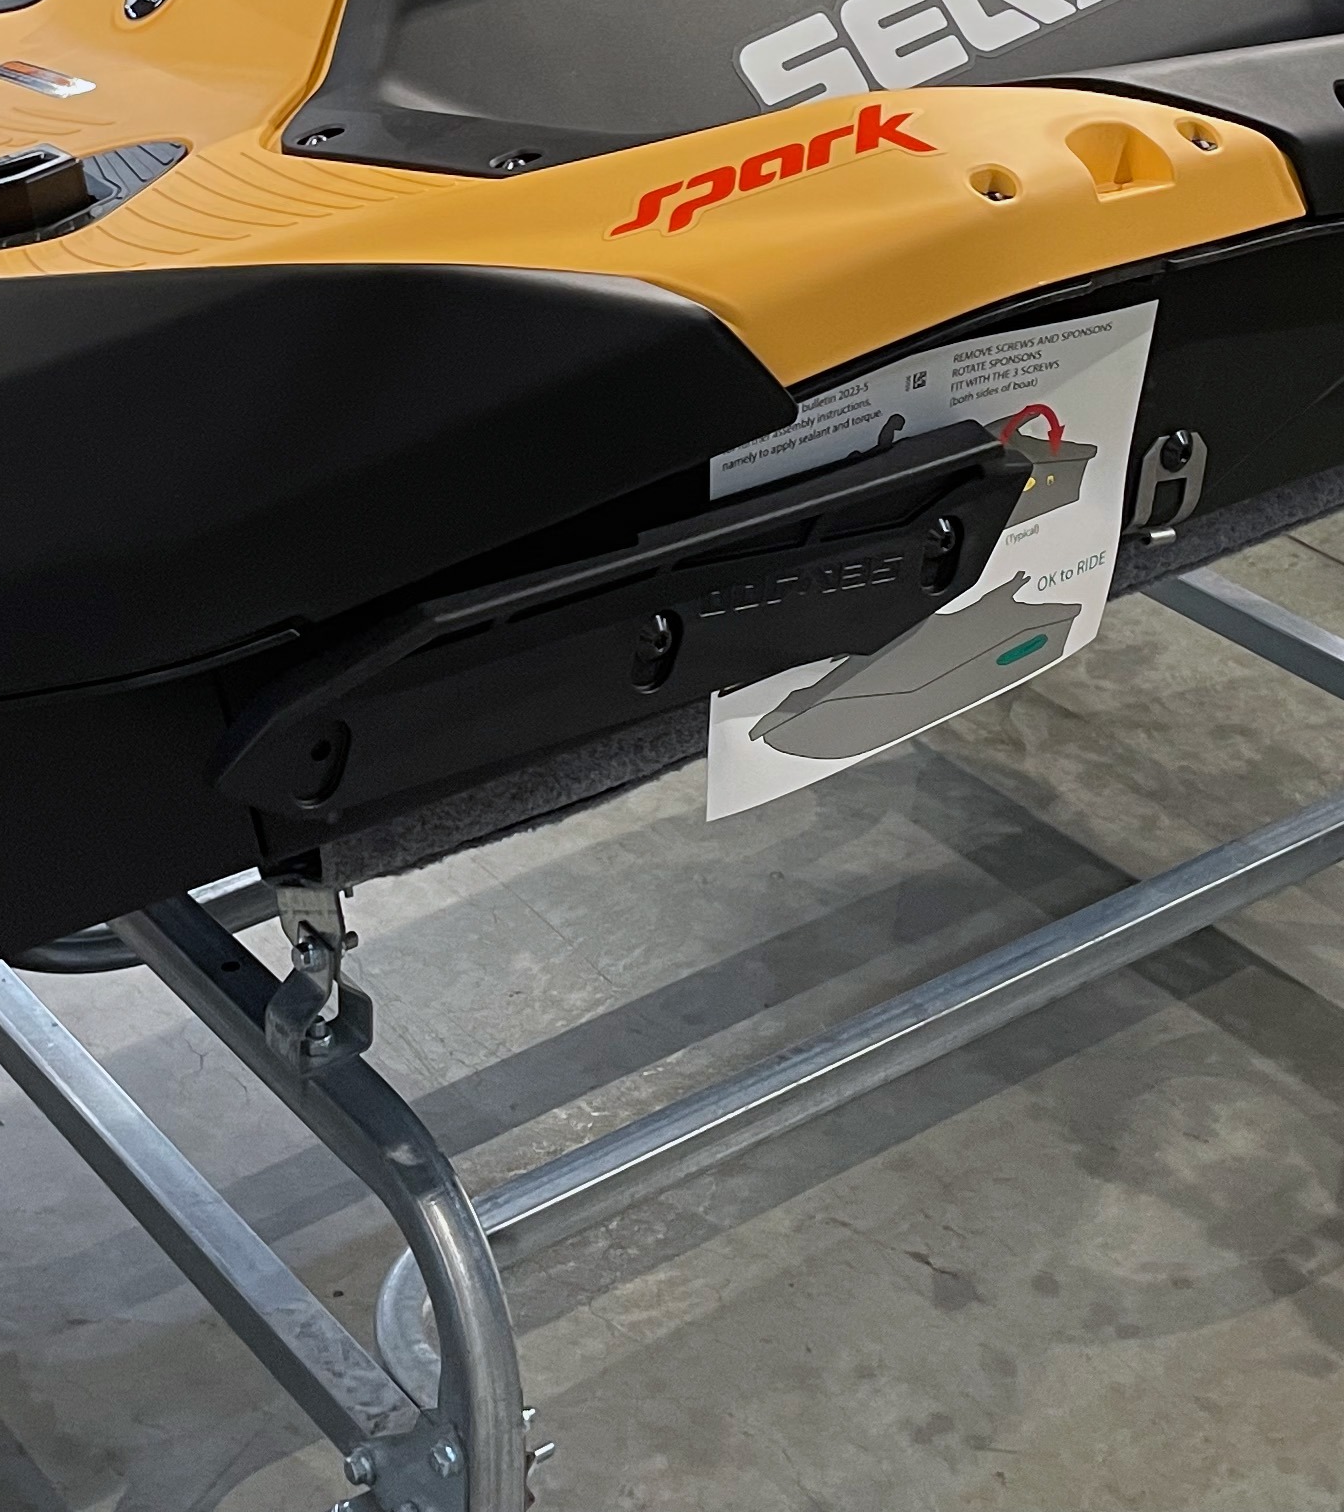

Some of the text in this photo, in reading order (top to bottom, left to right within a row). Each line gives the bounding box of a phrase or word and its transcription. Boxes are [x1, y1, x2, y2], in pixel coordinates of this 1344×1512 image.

[609, 104, 939, 236] spark
[953, 321, 1113, 364] REMOVE SCREWS AND SPONSONS
[950, 360, 1060, 393] FIT WITH THE 3 SCREWS
[952, 350, 1042, 378] ROTATE SPONSONS
[801, 382, 869, 413] bulletin 2023-5
[949, 390, 974, 408] (both
[975, 385, 999, 399] sides
[1013, 377, 1038, 391] boat)
[772, 417, 816, 439] assembly
[722, 451, 757, 472] namely
[759, 448, 770, 459] to
[770, 438, 797, 456] apply
[798, 425, 832, 446] sealant
[832, 418, 850, 432] and
[1005, 522, 1041, 546] (Typical)
[1037, 550, 1108, 593] OK to RIDE
